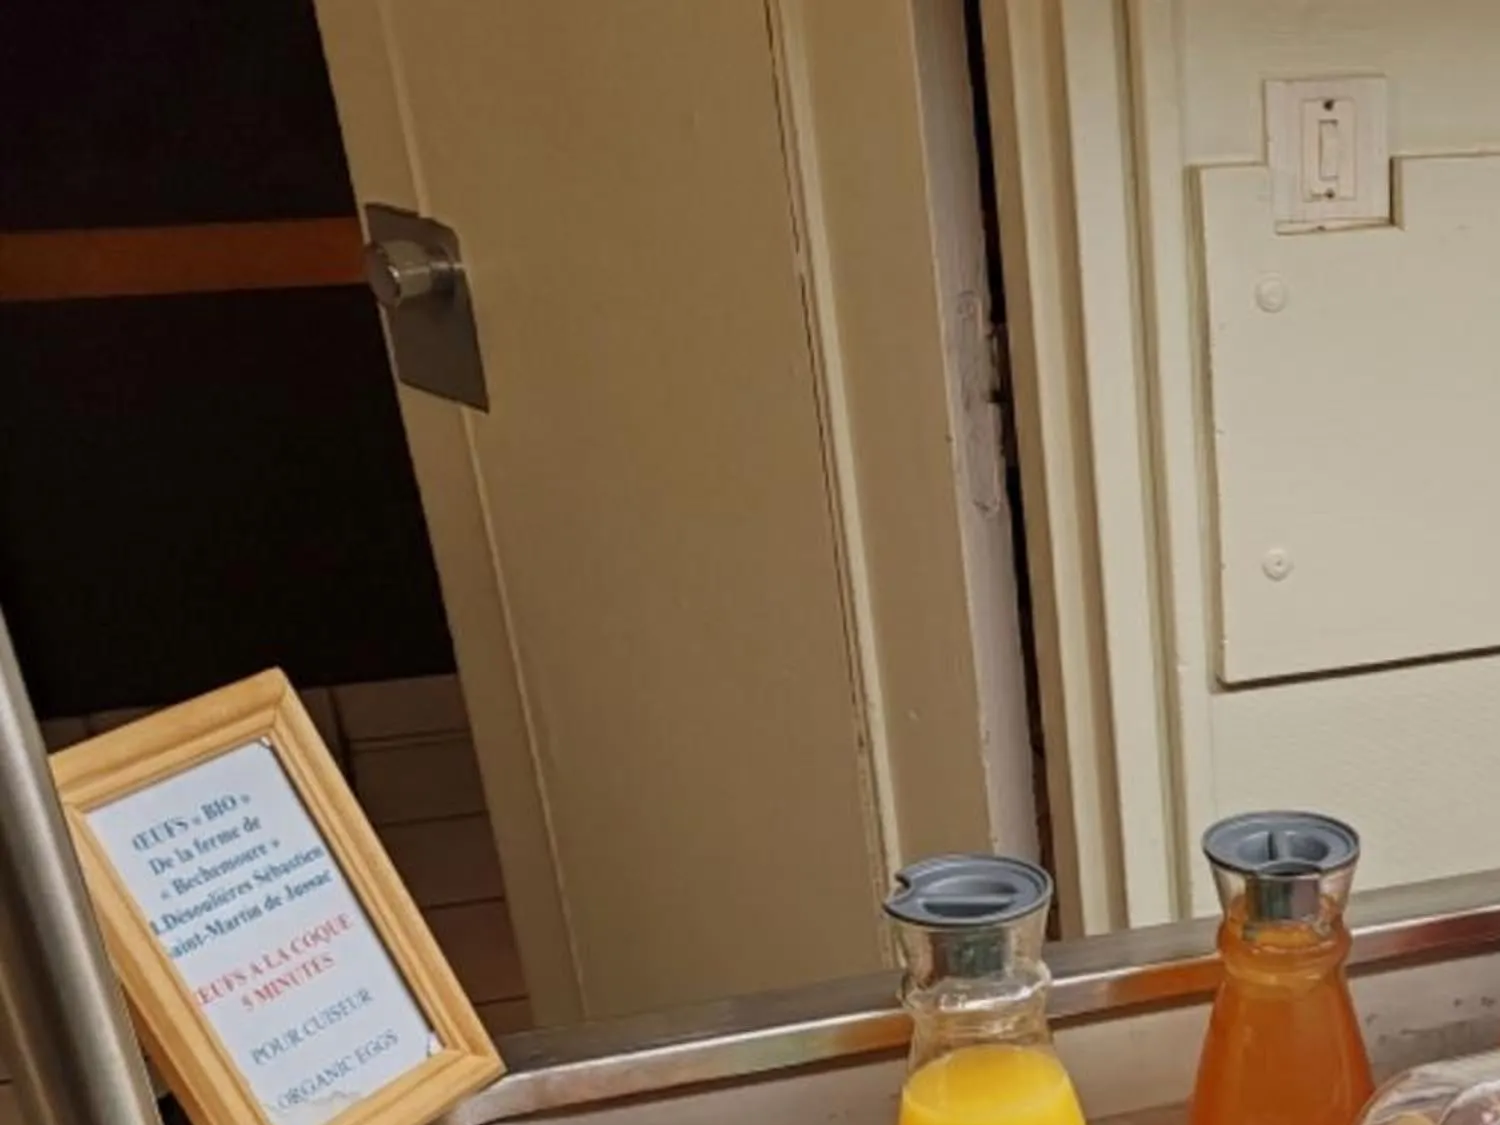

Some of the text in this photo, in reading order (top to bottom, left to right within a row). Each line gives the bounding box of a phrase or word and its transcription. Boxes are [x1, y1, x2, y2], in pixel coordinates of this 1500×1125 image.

[131, 818, 188, 851] ŒUFS
[201, 794, 238, 821] BIO
[149, 815, 262, 876] De la ferme de
[170, 903, 263, 958] aint-Martin
[263, 895, 283, 912] de
[290, 912, 353, 954] COQUE
[254, 953, 335, 1002] MINUTES
[250, 987, 374, 1067] POUR CUISEUR
[276, 1028, 399, 1112] ORGANIC EGGS
